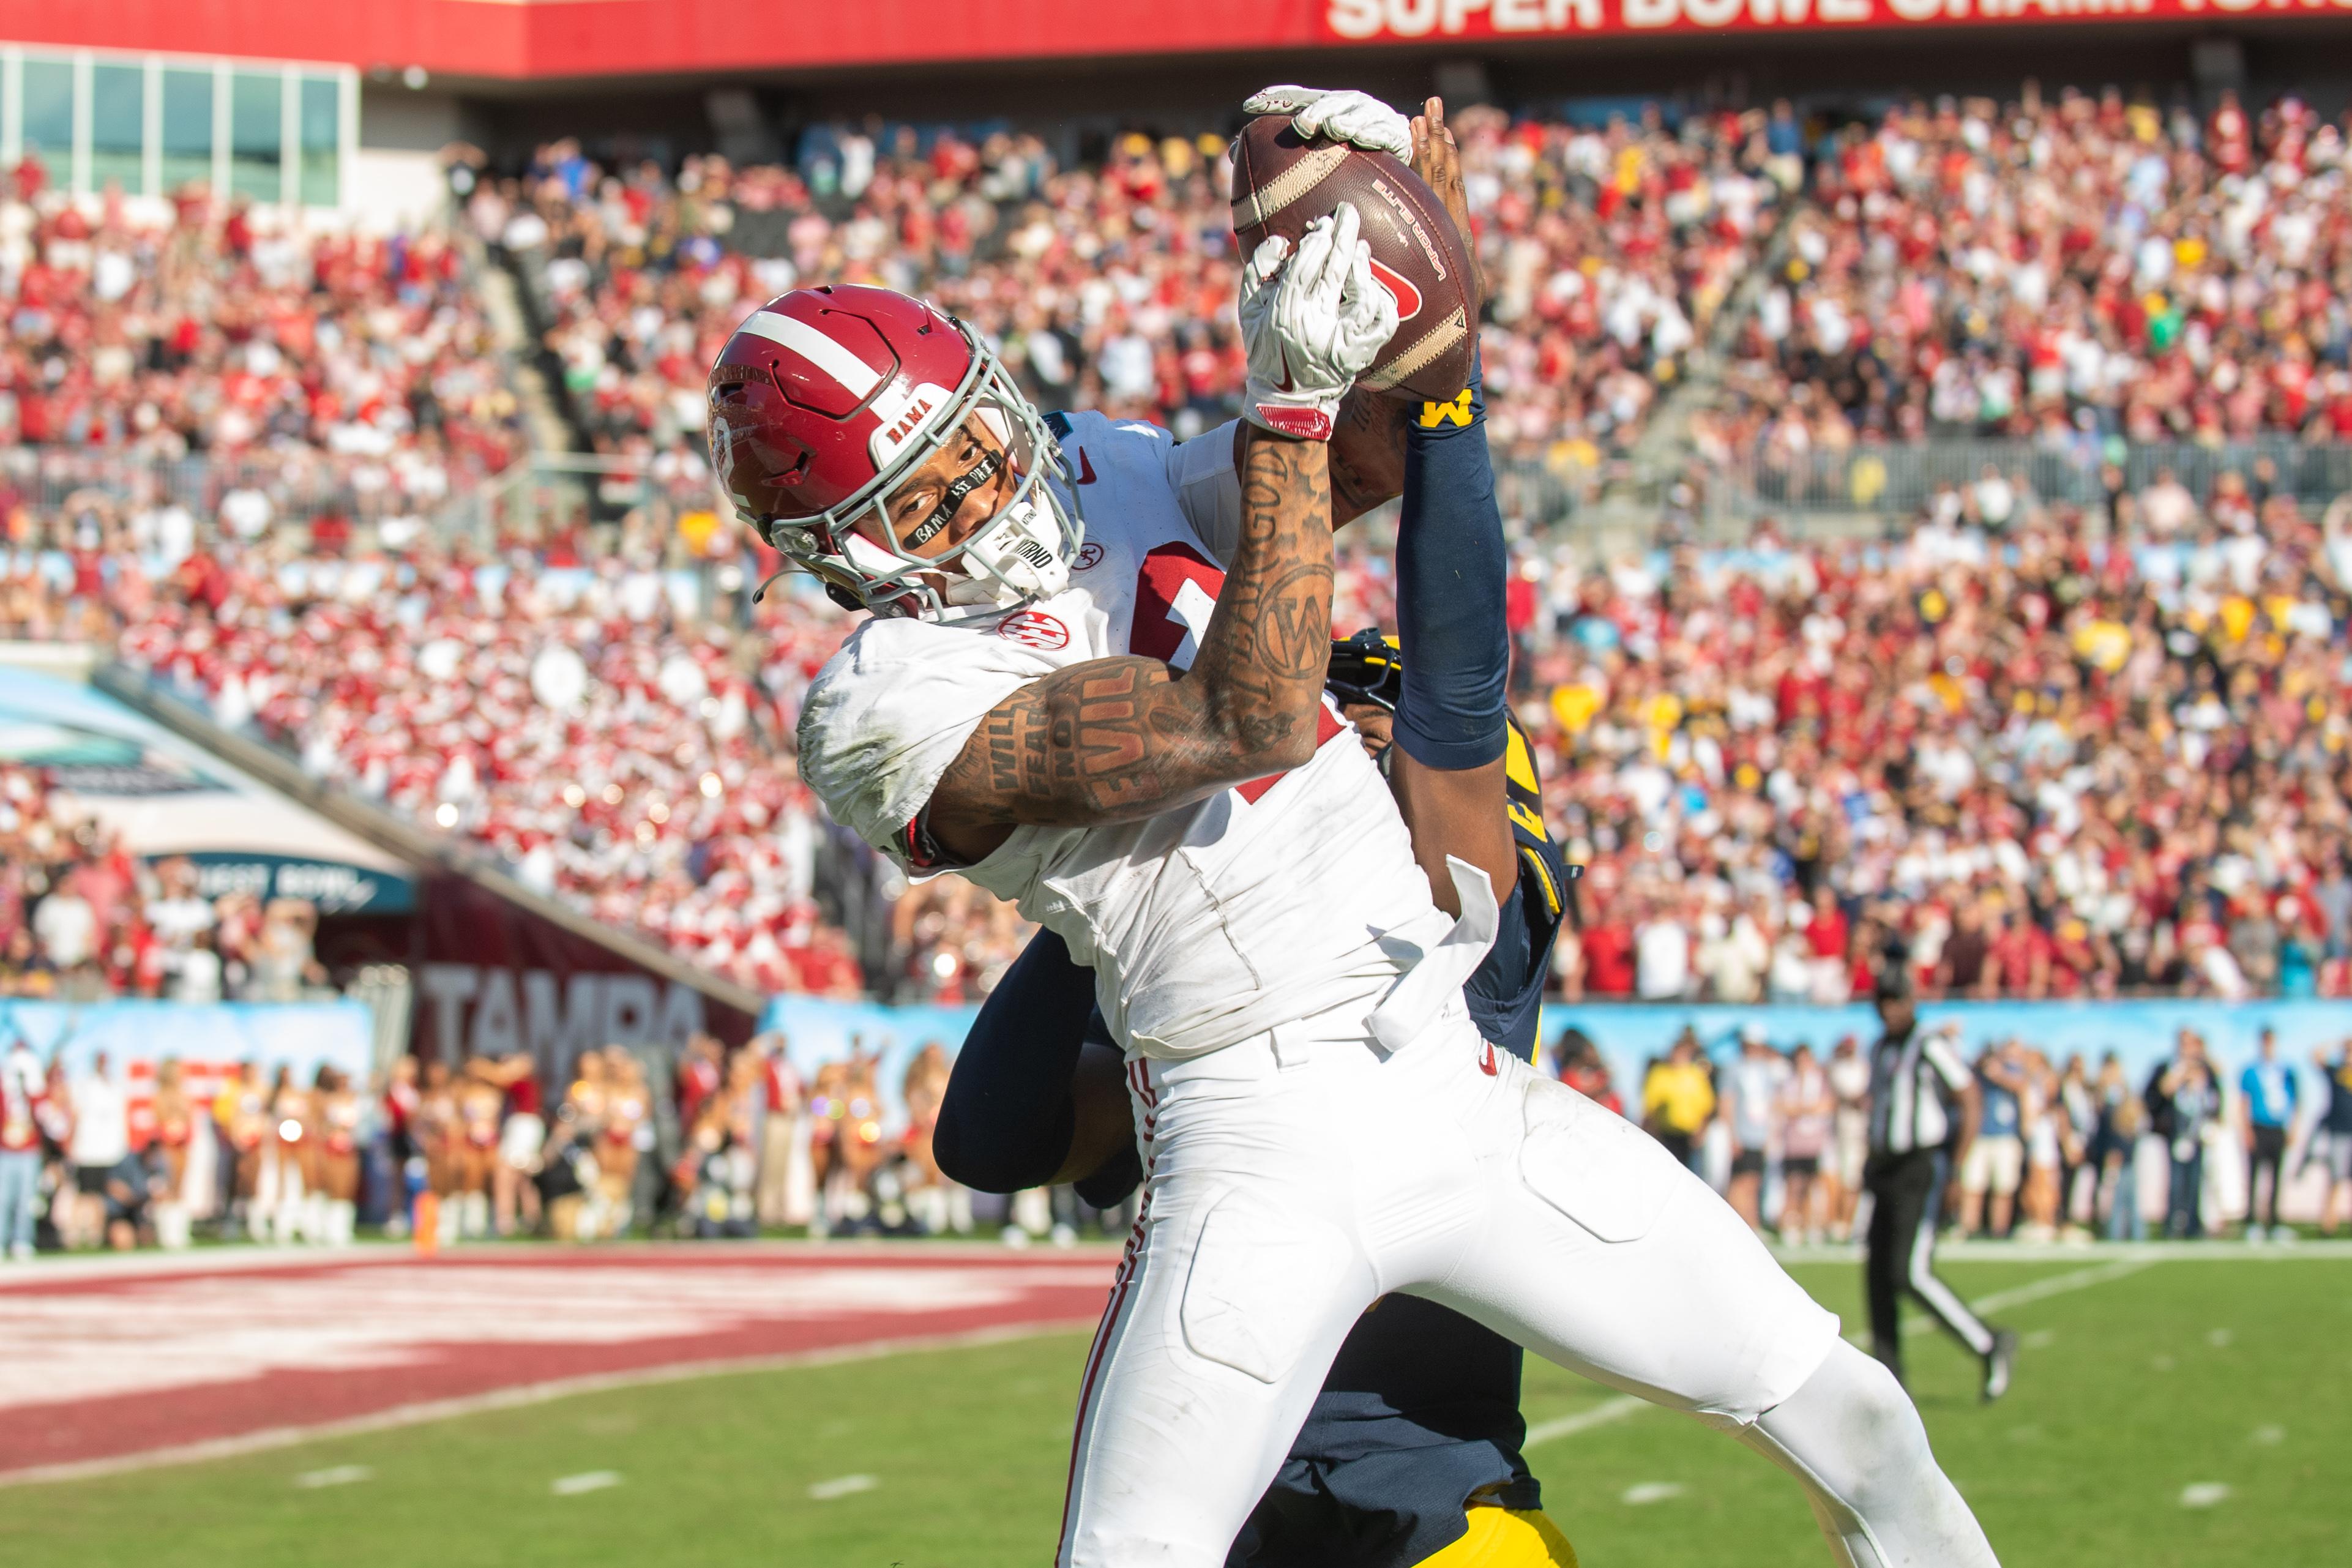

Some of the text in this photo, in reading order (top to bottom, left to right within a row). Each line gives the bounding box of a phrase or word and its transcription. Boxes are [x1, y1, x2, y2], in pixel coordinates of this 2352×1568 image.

[1326, 0, 1605, 39] SUPER
[1372, 179, 1415, 225] ELITE
[1413, 221, 1447, 282] VAPOR
[886, 398, 933, 446] BAMA
[1419, 388, 1474, 428] M
[915, 504, 953, 544] BAMA
[1244, 445, 1288, 547] GOD
[988, 709, 1020, 791] WILL
[1025, 706, 1051, 796] FEAR
[1053, 720, 1076, 777] NO
[1078, 665, 1162, 810] EVIL
[421, 963, 706, 1074] TAMPA
